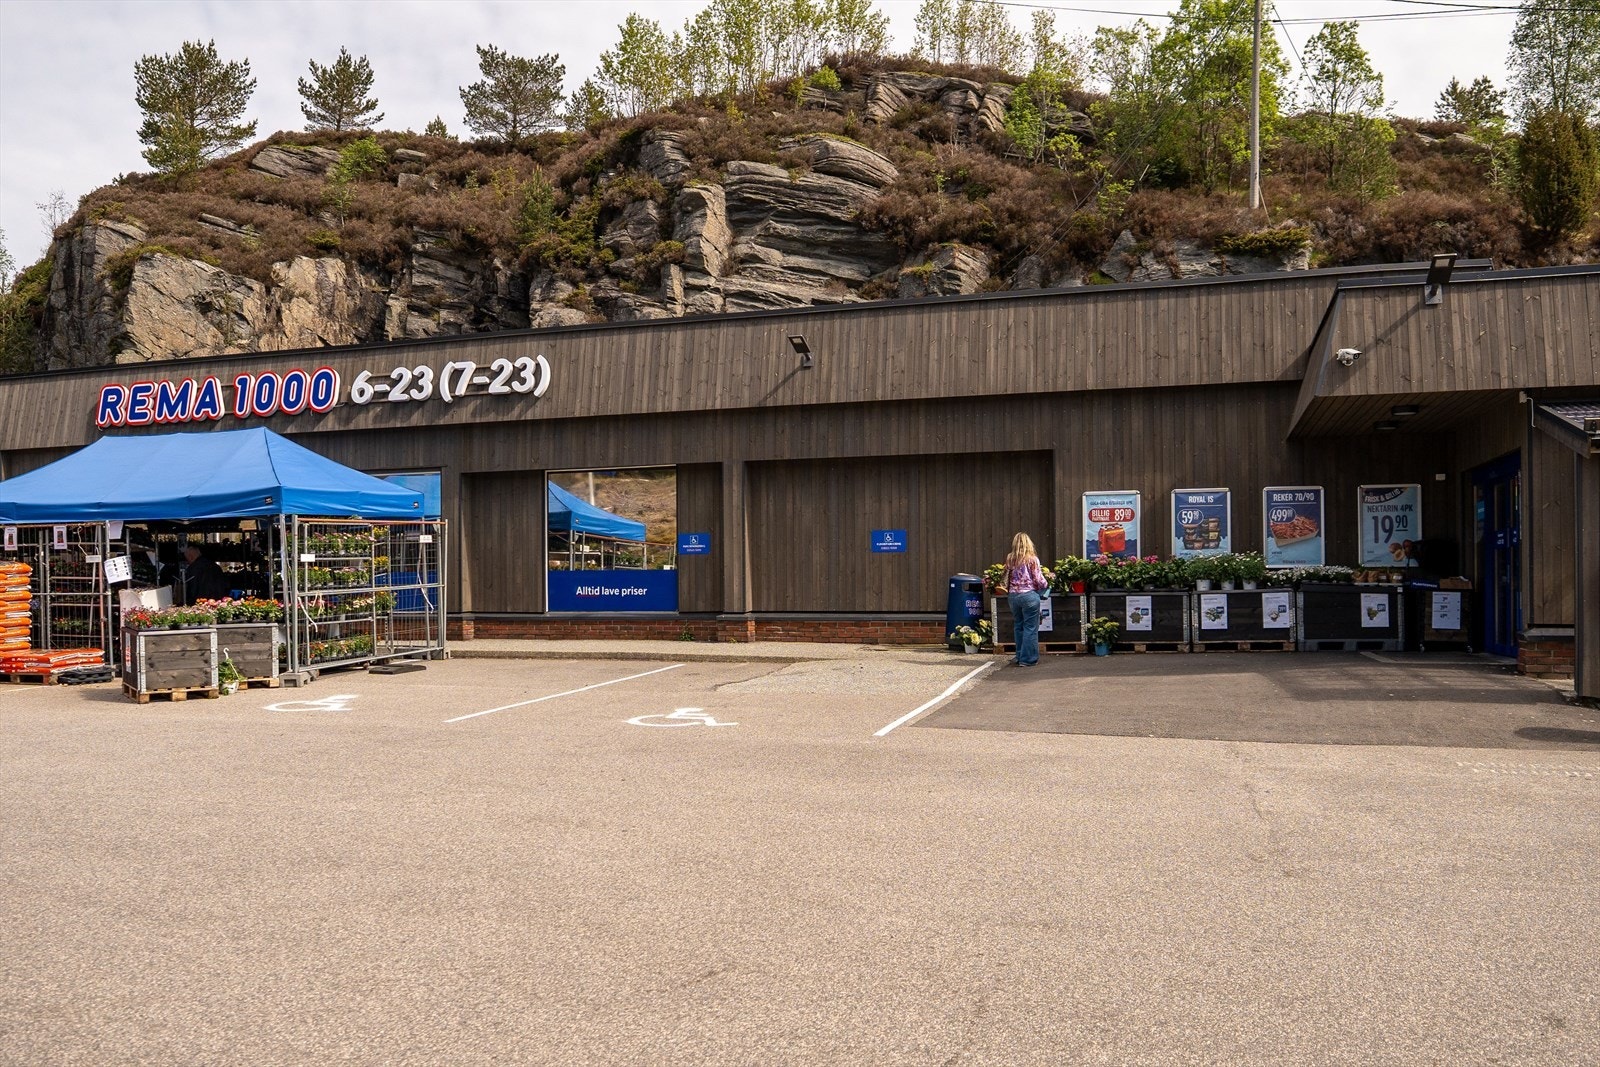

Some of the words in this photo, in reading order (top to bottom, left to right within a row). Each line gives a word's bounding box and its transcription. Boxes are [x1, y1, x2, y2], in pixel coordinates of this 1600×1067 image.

[351, 365, 434, 405] 6-23
[440, 354, 551, 403] (7-23)
[96, 375, 226, 428] REMA
[233, 366, 341, 419] 1000
[1188, 496, 1206, 504] ROYAL
[1207, 495, 1214, 503] IS
[1273, 493, 1294, 502] REKER
[1295, 492, 1315, 501] 70/90
[1091, 509, 1110, 517] BILLIG
[1367, 505, 1399, 513] NEKTARIN
[1400, 504, 1414, 512] 4PK
[576, 586, 600, 595] Alltid
[602, 586, 620, 595] lave
[621, 586, 648, 597] priser
